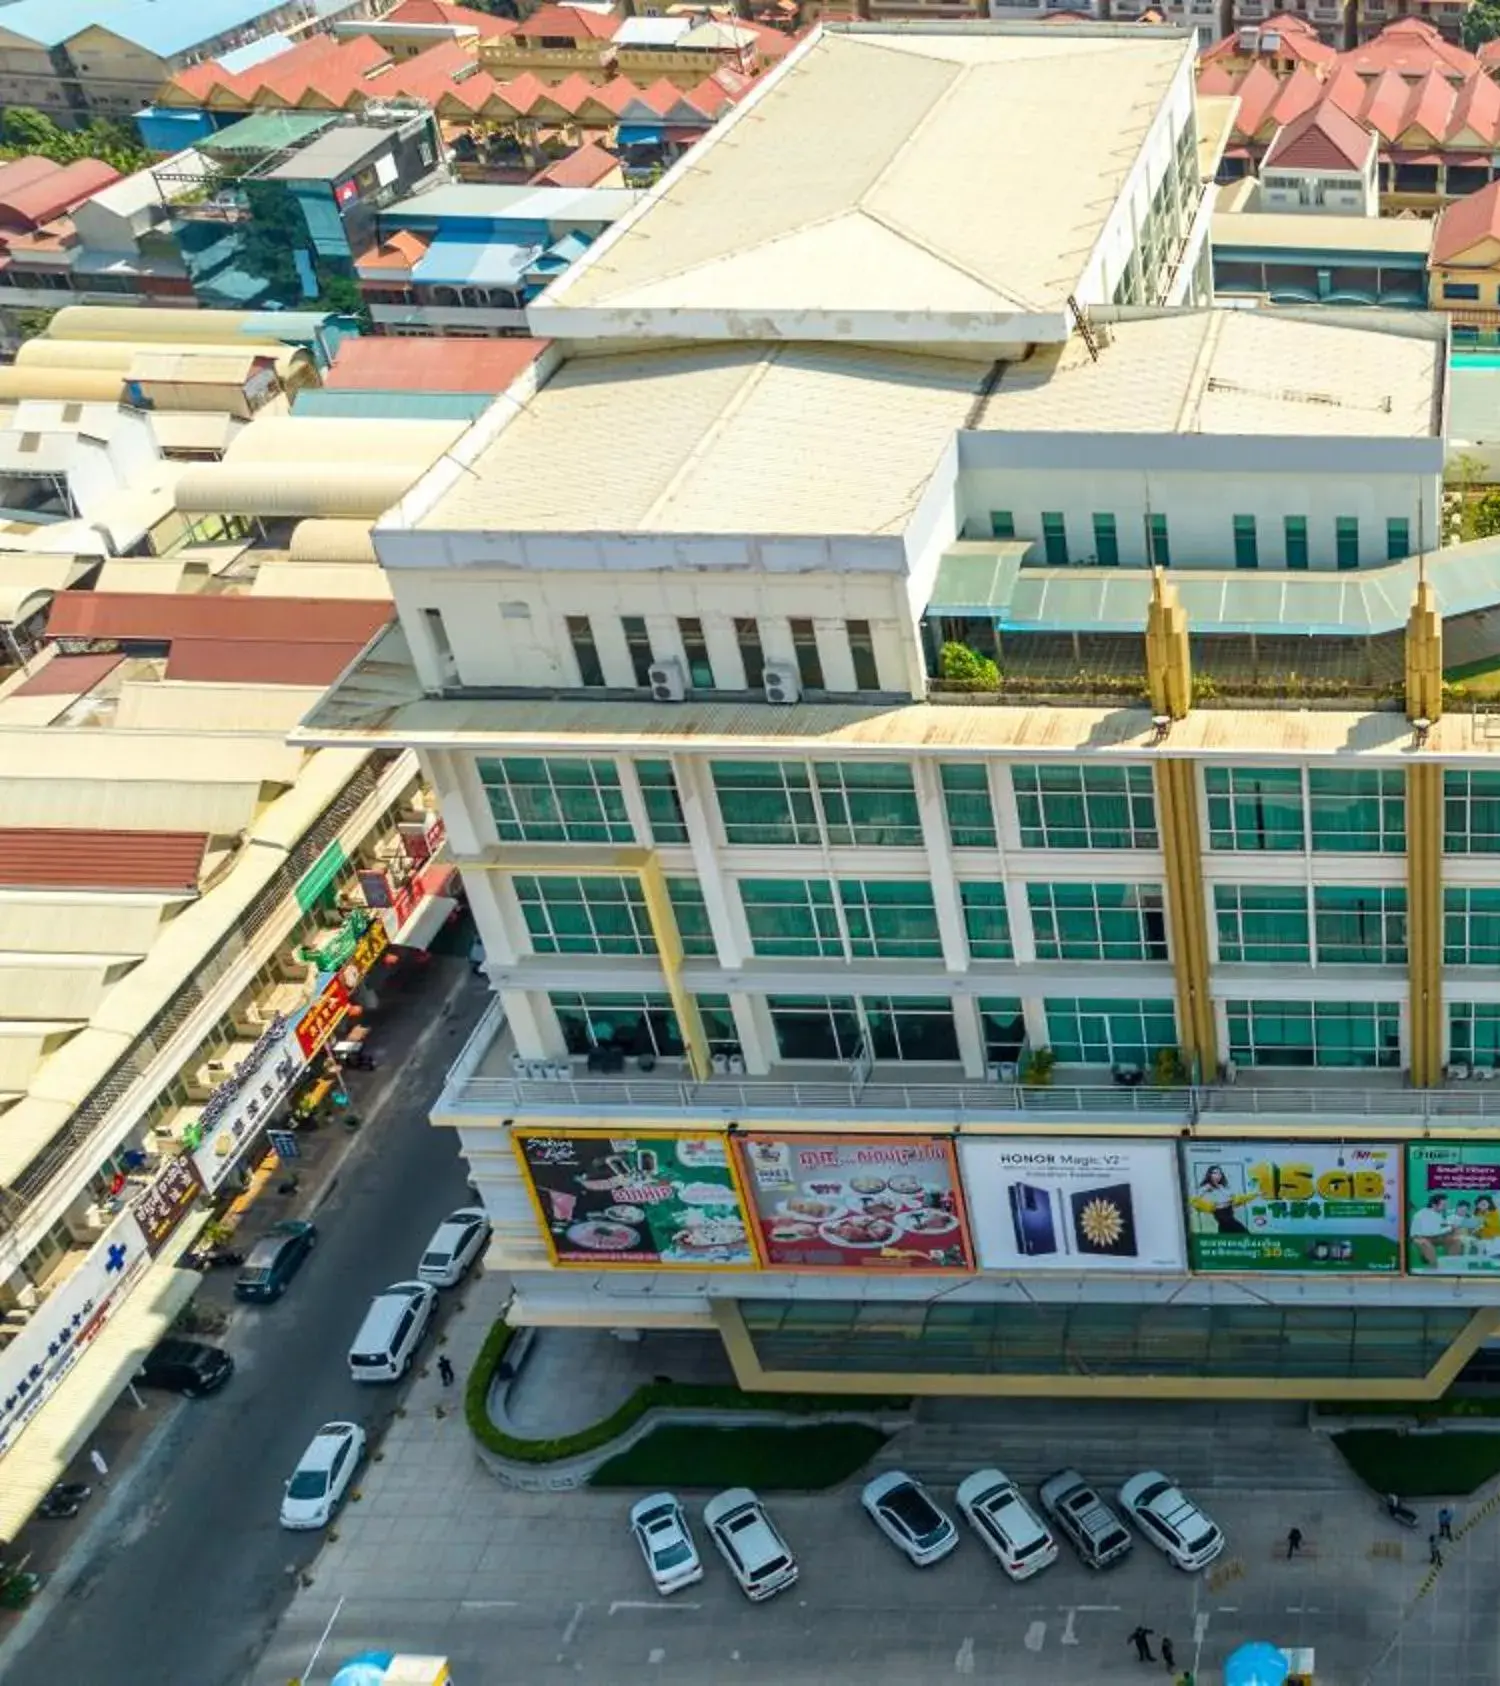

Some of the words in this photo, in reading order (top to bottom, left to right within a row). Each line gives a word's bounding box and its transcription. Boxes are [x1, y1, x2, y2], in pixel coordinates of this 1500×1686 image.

[1001, 1153, 1055, 1164] HONOR
[1060, 1154, 1100, 1167] Magic
[1248, 1161, 1385, 1201] 15GB
